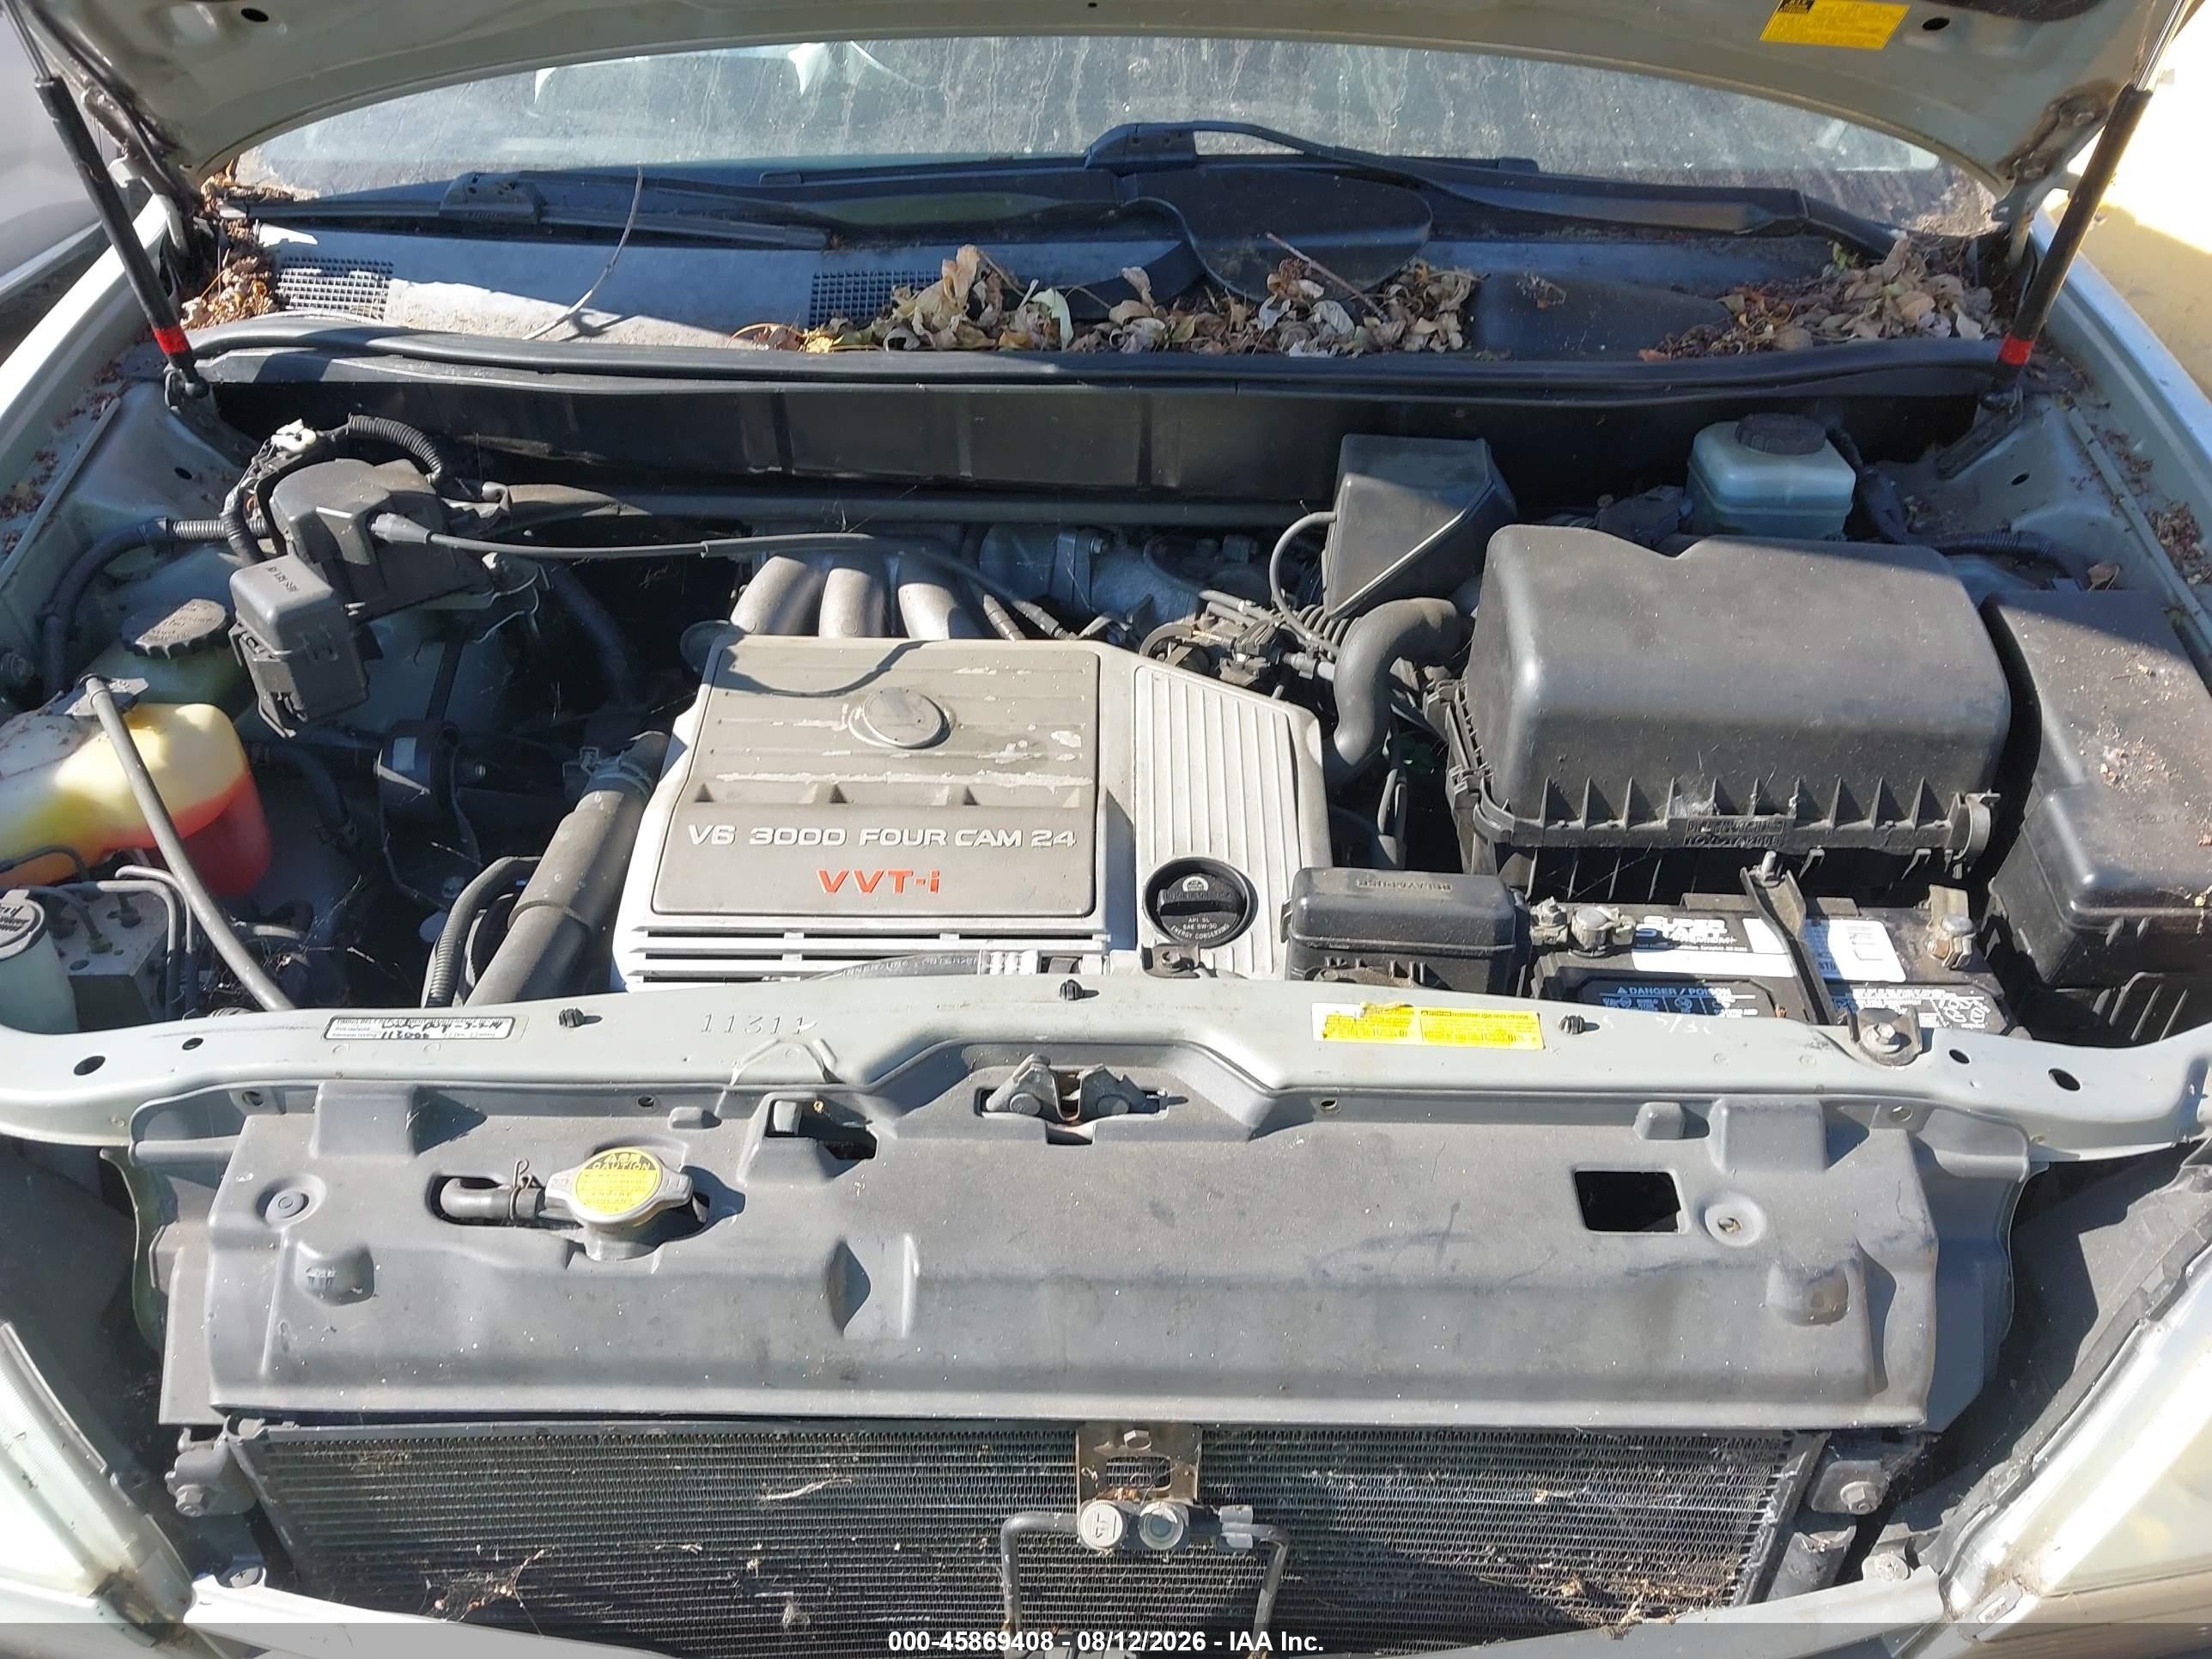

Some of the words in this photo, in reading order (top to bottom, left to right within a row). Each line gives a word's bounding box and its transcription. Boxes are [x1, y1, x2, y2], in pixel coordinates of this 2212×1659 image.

[688, 824, 736, 847] V6
[749, 826, 848, 848] 3000
[859, 827, 948, 848] FOUR
[954, 829, 1023, 848] CAM
[1030, 830, 1077, 848] 24
[817, 868, 941, 895] VVT-i
[1170, 925, 1194, 939] ENERGY
[1629, 987, 1677, 996] DANGER
[1688, 988, 1732, 998] POISON
[592, 1161, 651, 1171] CAUTION
